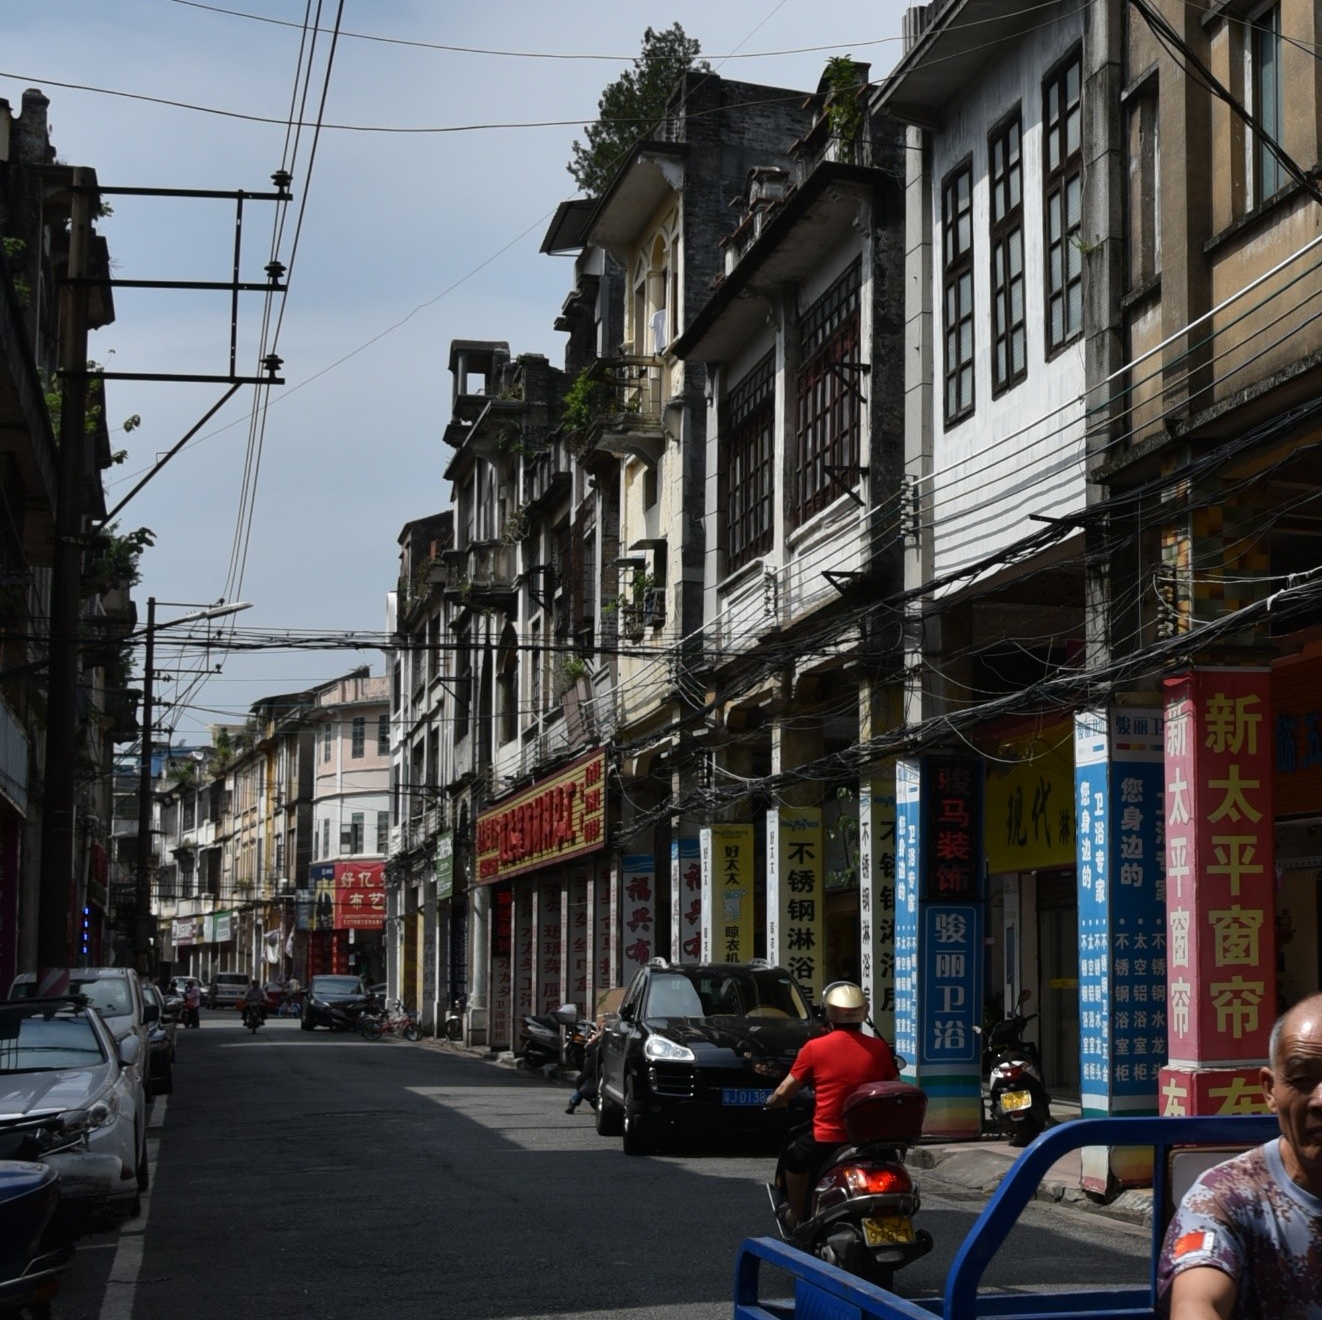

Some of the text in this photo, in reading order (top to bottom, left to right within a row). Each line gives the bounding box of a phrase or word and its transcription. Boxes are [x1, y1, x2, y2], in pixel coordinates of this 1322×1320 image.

[724, 845, 740, 886] 好太太
[933, 766, 973, 893] 骏马装饰
[1120, 776, 1144, 888] 您身边的
[1164, 697, 1192, 1039] 新太平窗帘
[1205, 692, 1266, 1039] 新太平窗帘
[725, 925, 740, 964] 晾衣机
[933, 912, 967, 1051] 骏丽卫浴
[1115, 932, 1131, 1082] 不锈钢浴室柜
[1133, 932, 1148, 1082] 太空铝浴室柜
